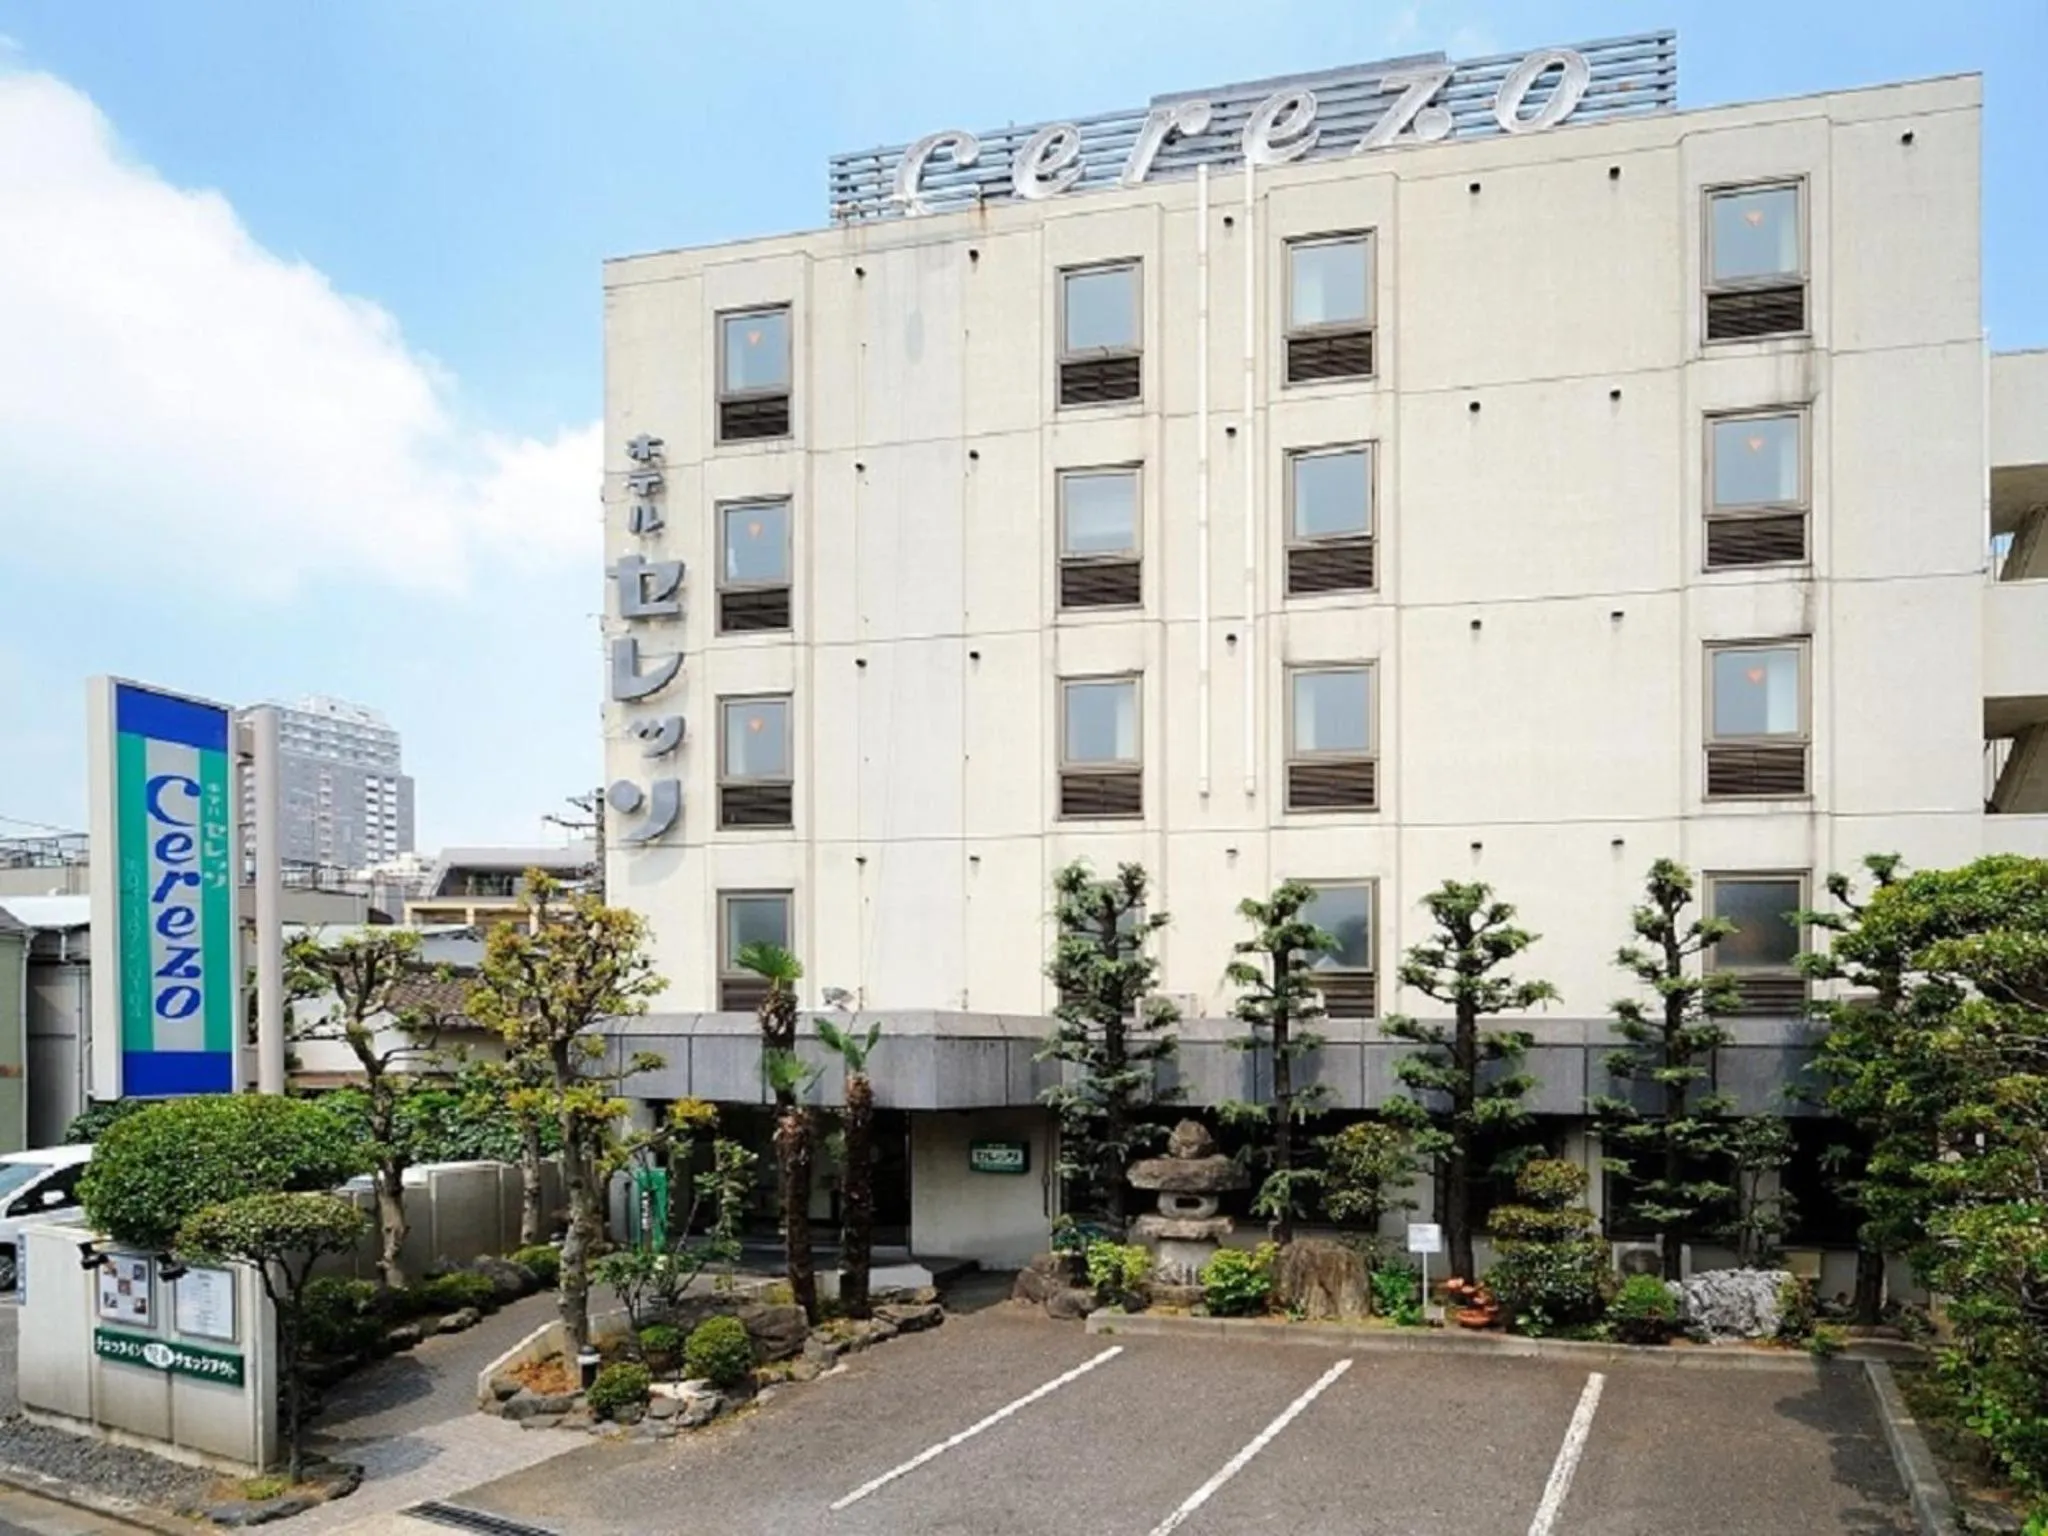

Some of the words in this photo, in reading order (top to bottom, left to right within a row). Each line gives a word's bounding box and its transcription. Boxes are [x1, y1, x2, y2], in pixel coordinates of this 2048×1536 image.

[626, 433, 665, 536] ホテル
[607, 553, 686, 843] セレッソ
[145, 774, 202, 1020] Cerezo
